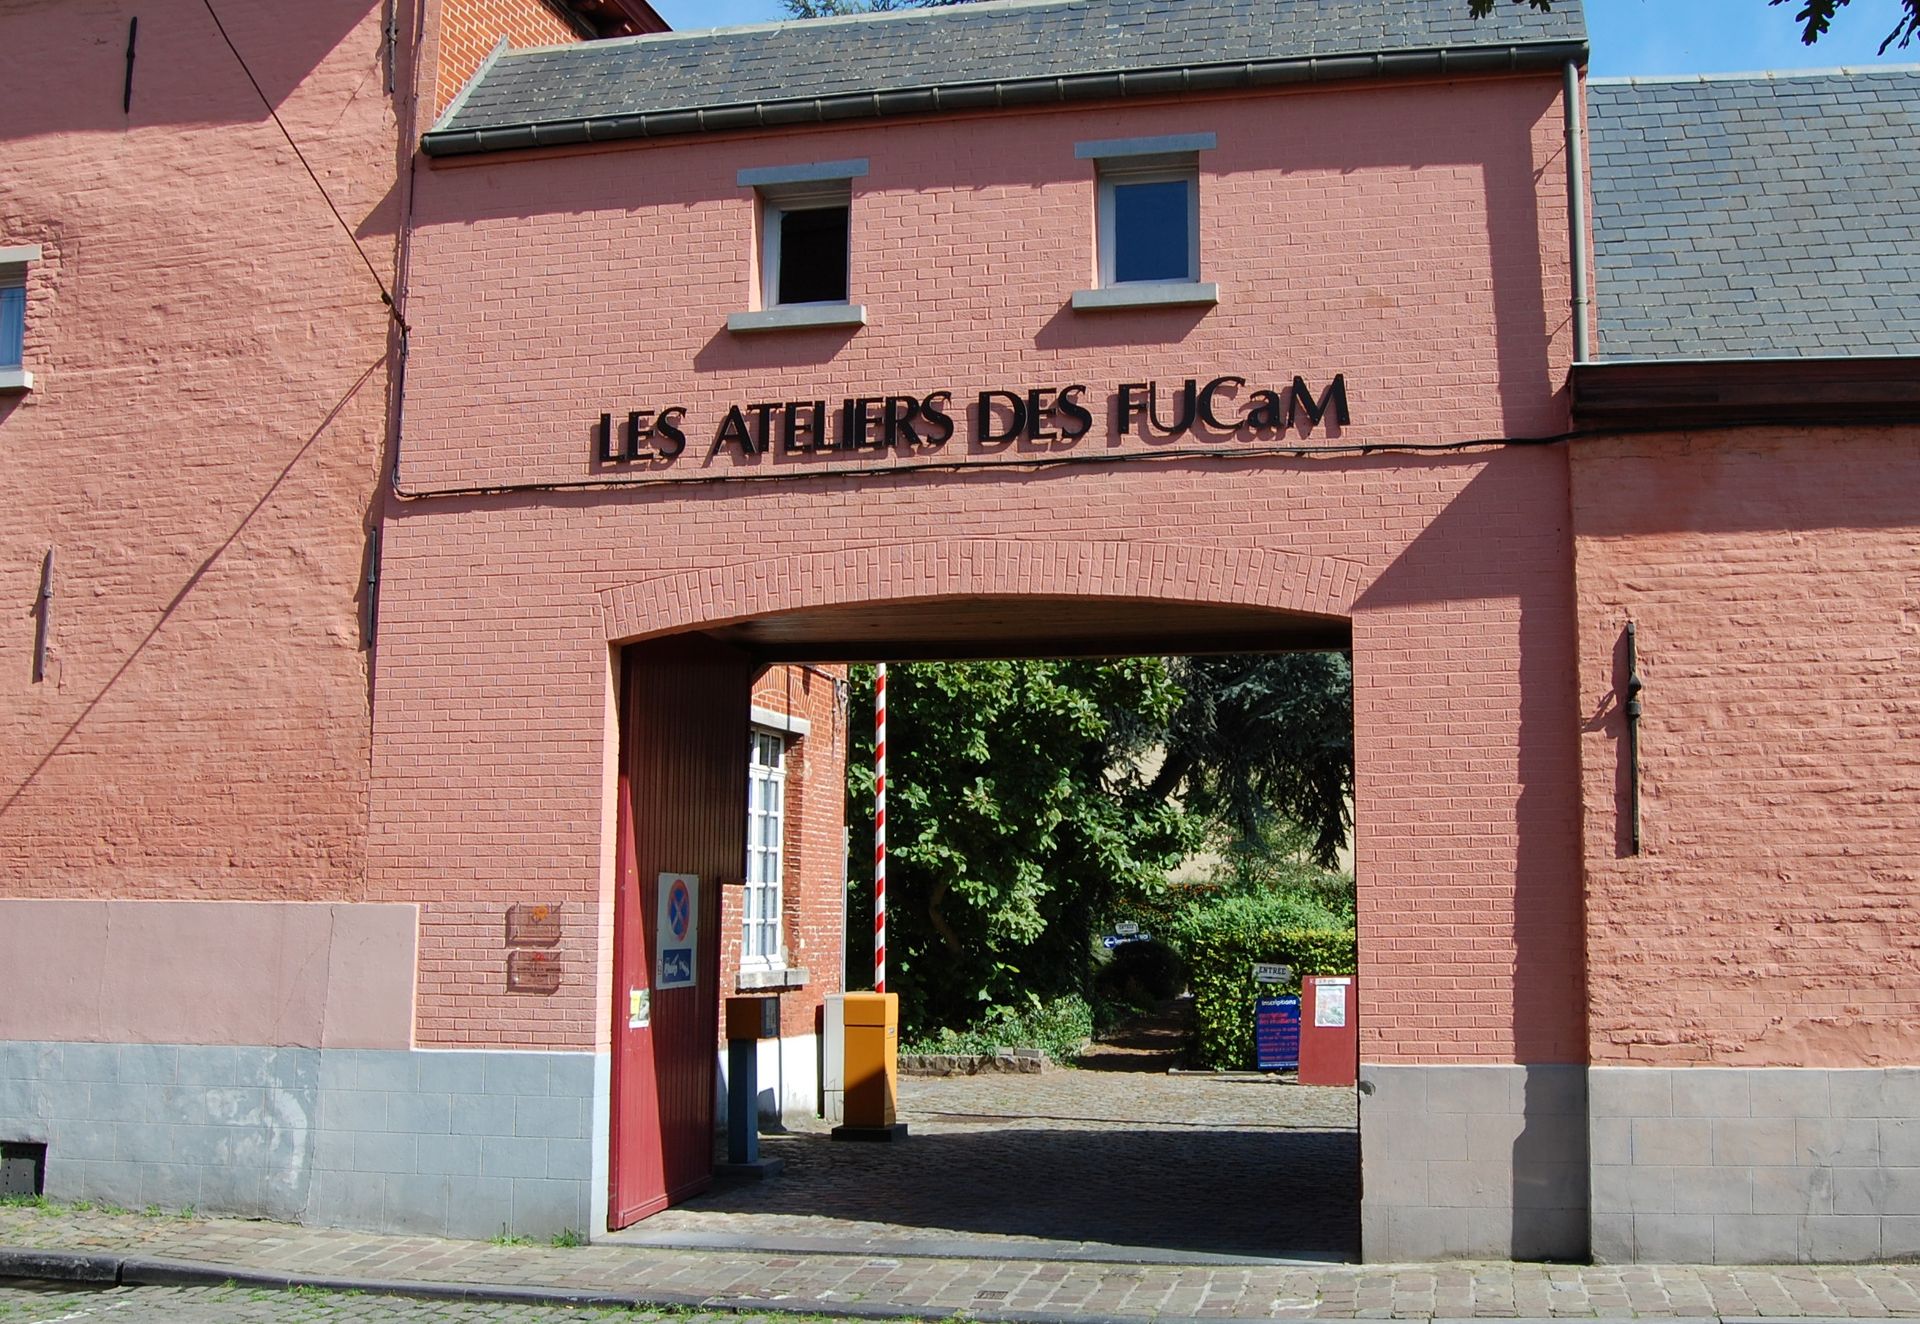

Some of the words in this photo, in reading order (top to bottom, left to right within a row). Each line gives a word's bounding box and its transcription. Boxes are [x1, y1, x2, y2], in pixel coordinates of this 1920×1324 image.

[600, 406, 686, 463] LES
[714, 391, 954, 456] ATELIERS
[977, 384, 1093, 443] DES
[1117, 373, 1349, 436] FUCaM
